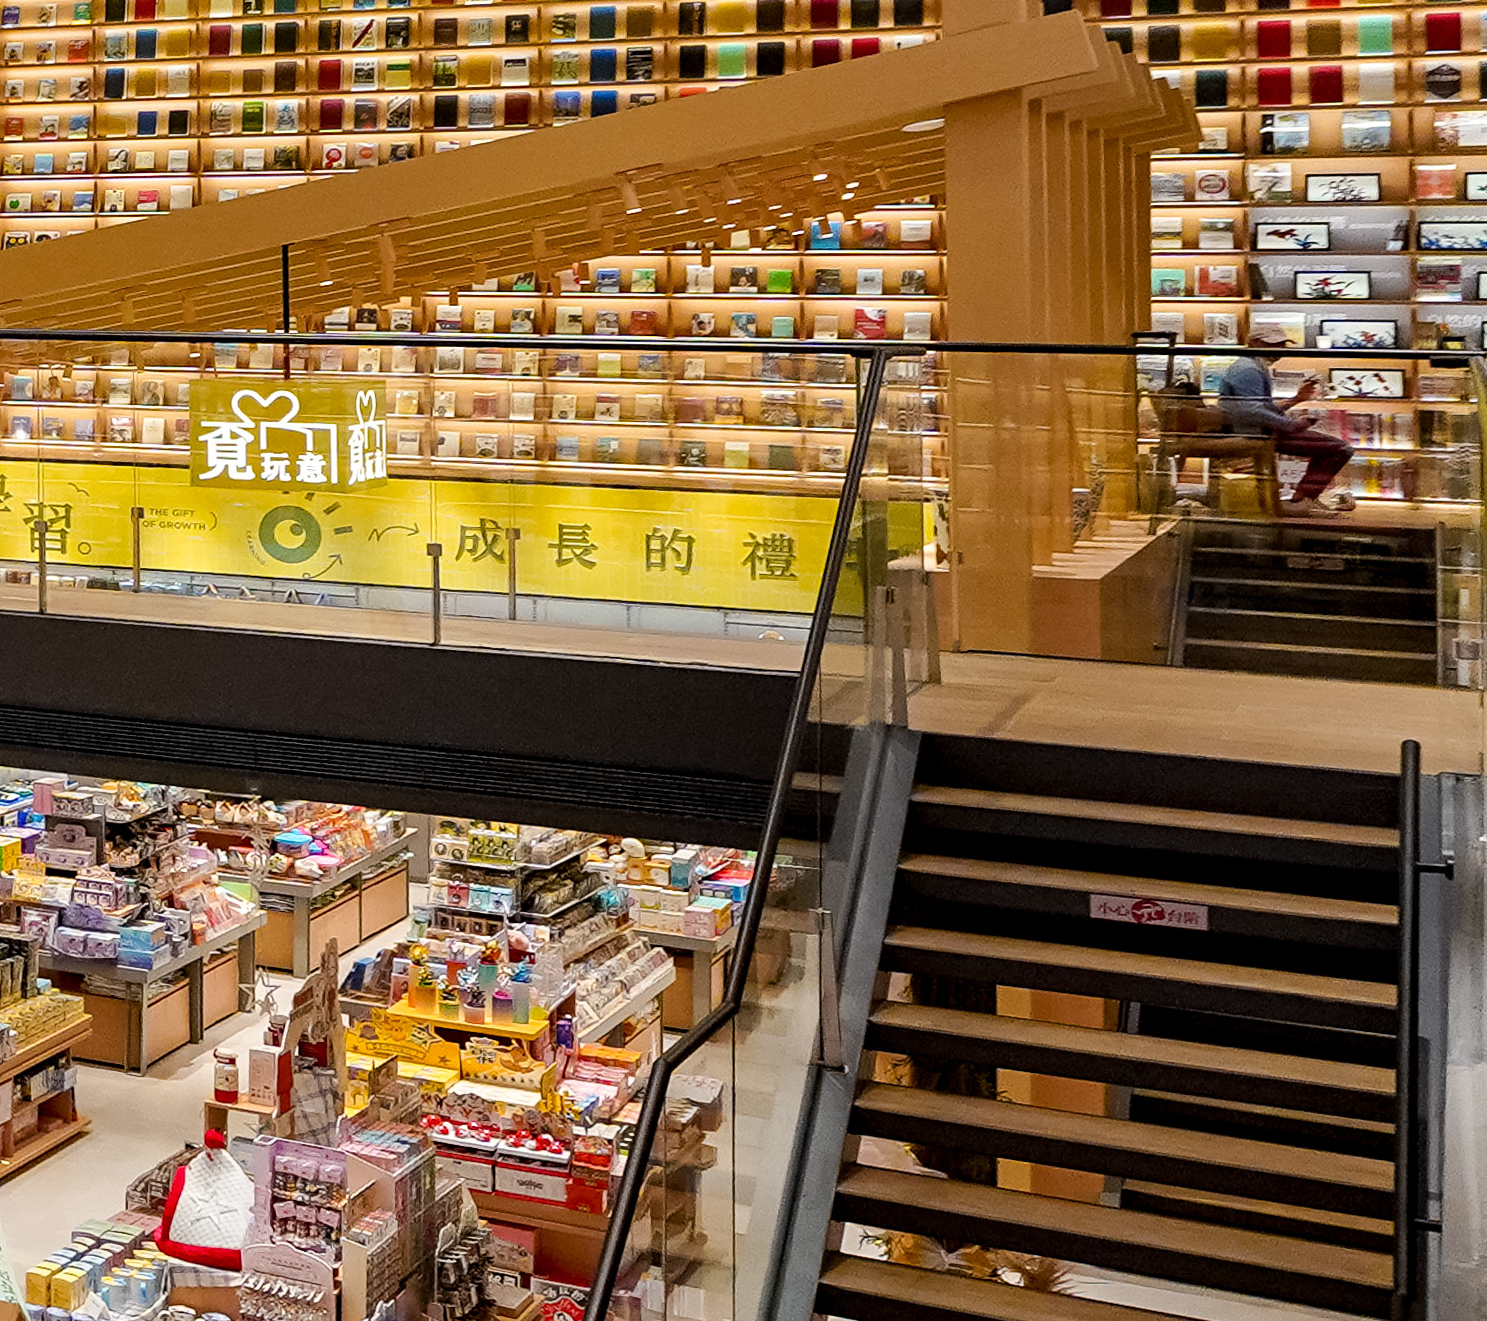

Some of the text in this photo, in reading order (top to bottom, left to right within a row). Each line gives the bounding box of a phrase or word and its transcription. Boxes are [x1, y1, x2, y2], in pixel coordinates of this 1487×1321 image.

[148, 507, 195, 519] THE GIFT
[156, 520, 207, 532] GROWTH
[1096, 900, 1203, 928] 小心 台阶
